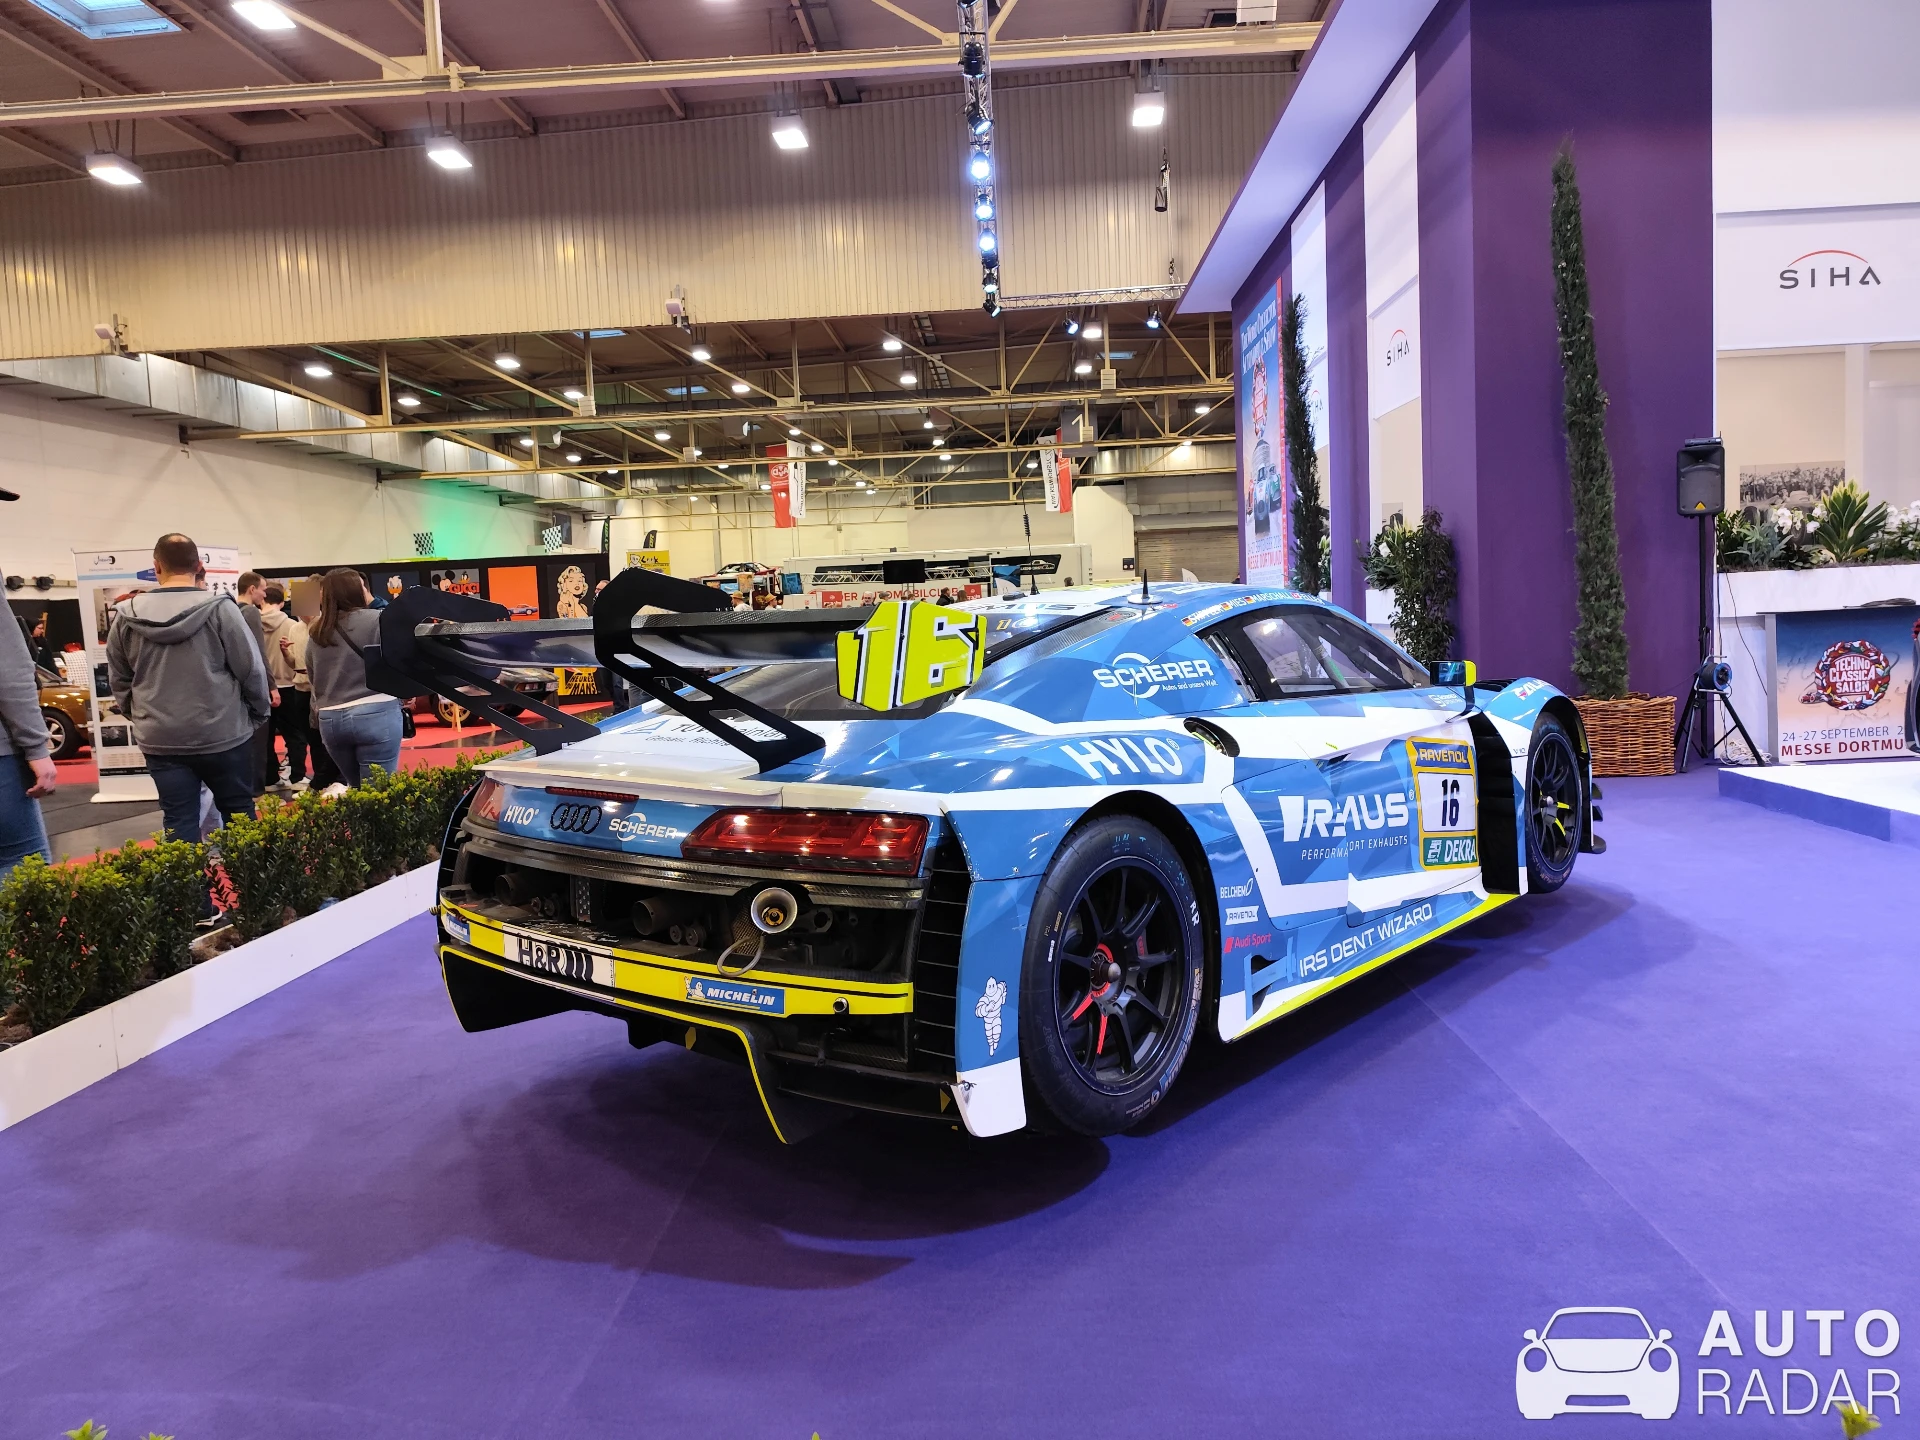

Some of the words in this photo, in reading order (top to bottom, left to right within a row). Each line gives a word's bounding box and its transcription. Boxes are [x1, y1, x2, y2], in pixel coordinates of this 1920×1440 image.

[1780, 266, 1881, 289] SIHA
[1386, 339, 1410, 366] SIHA
[841, 592, 858, 601] ER
[1835, 655, 1870, 671] TECHNO
[1092, 659, 1214, 688] SCHERER
[1829, 665, 1876, 682] CLASSICA
[1836, 681, 1870, 693] SALON
[1783, 732, 1796, 742] 24
[1821, 726, 1889, 740] SEPTEMBER
[1419, 748, 1468, 764] RAVENOL
[1781, 743, 1832, 756] MESSE
[1838, 739, 1904, 753] DORTMU
[1441, 779, 1460, 827] 16
[609, 818, 678, 840] SCHERER
[1368, 834, 1408, 849] EXHAUSTS
[1444, 839, 1477, 863] DEKRA
[1220, 884, 1248, 899] BELCHEM
[1229, 910, 1256, 921] RAVENOL
[1234, 935, 1252, 949] Audi
[1252, 932, 1272, 948] Sport
[1299, 949, 1328, 978] IRS
[1330, 928, 1375, 964] DENT
[1377, 903, 1433, 941] WIZARD
[706, 987, 776, 1006] MICHELIN
